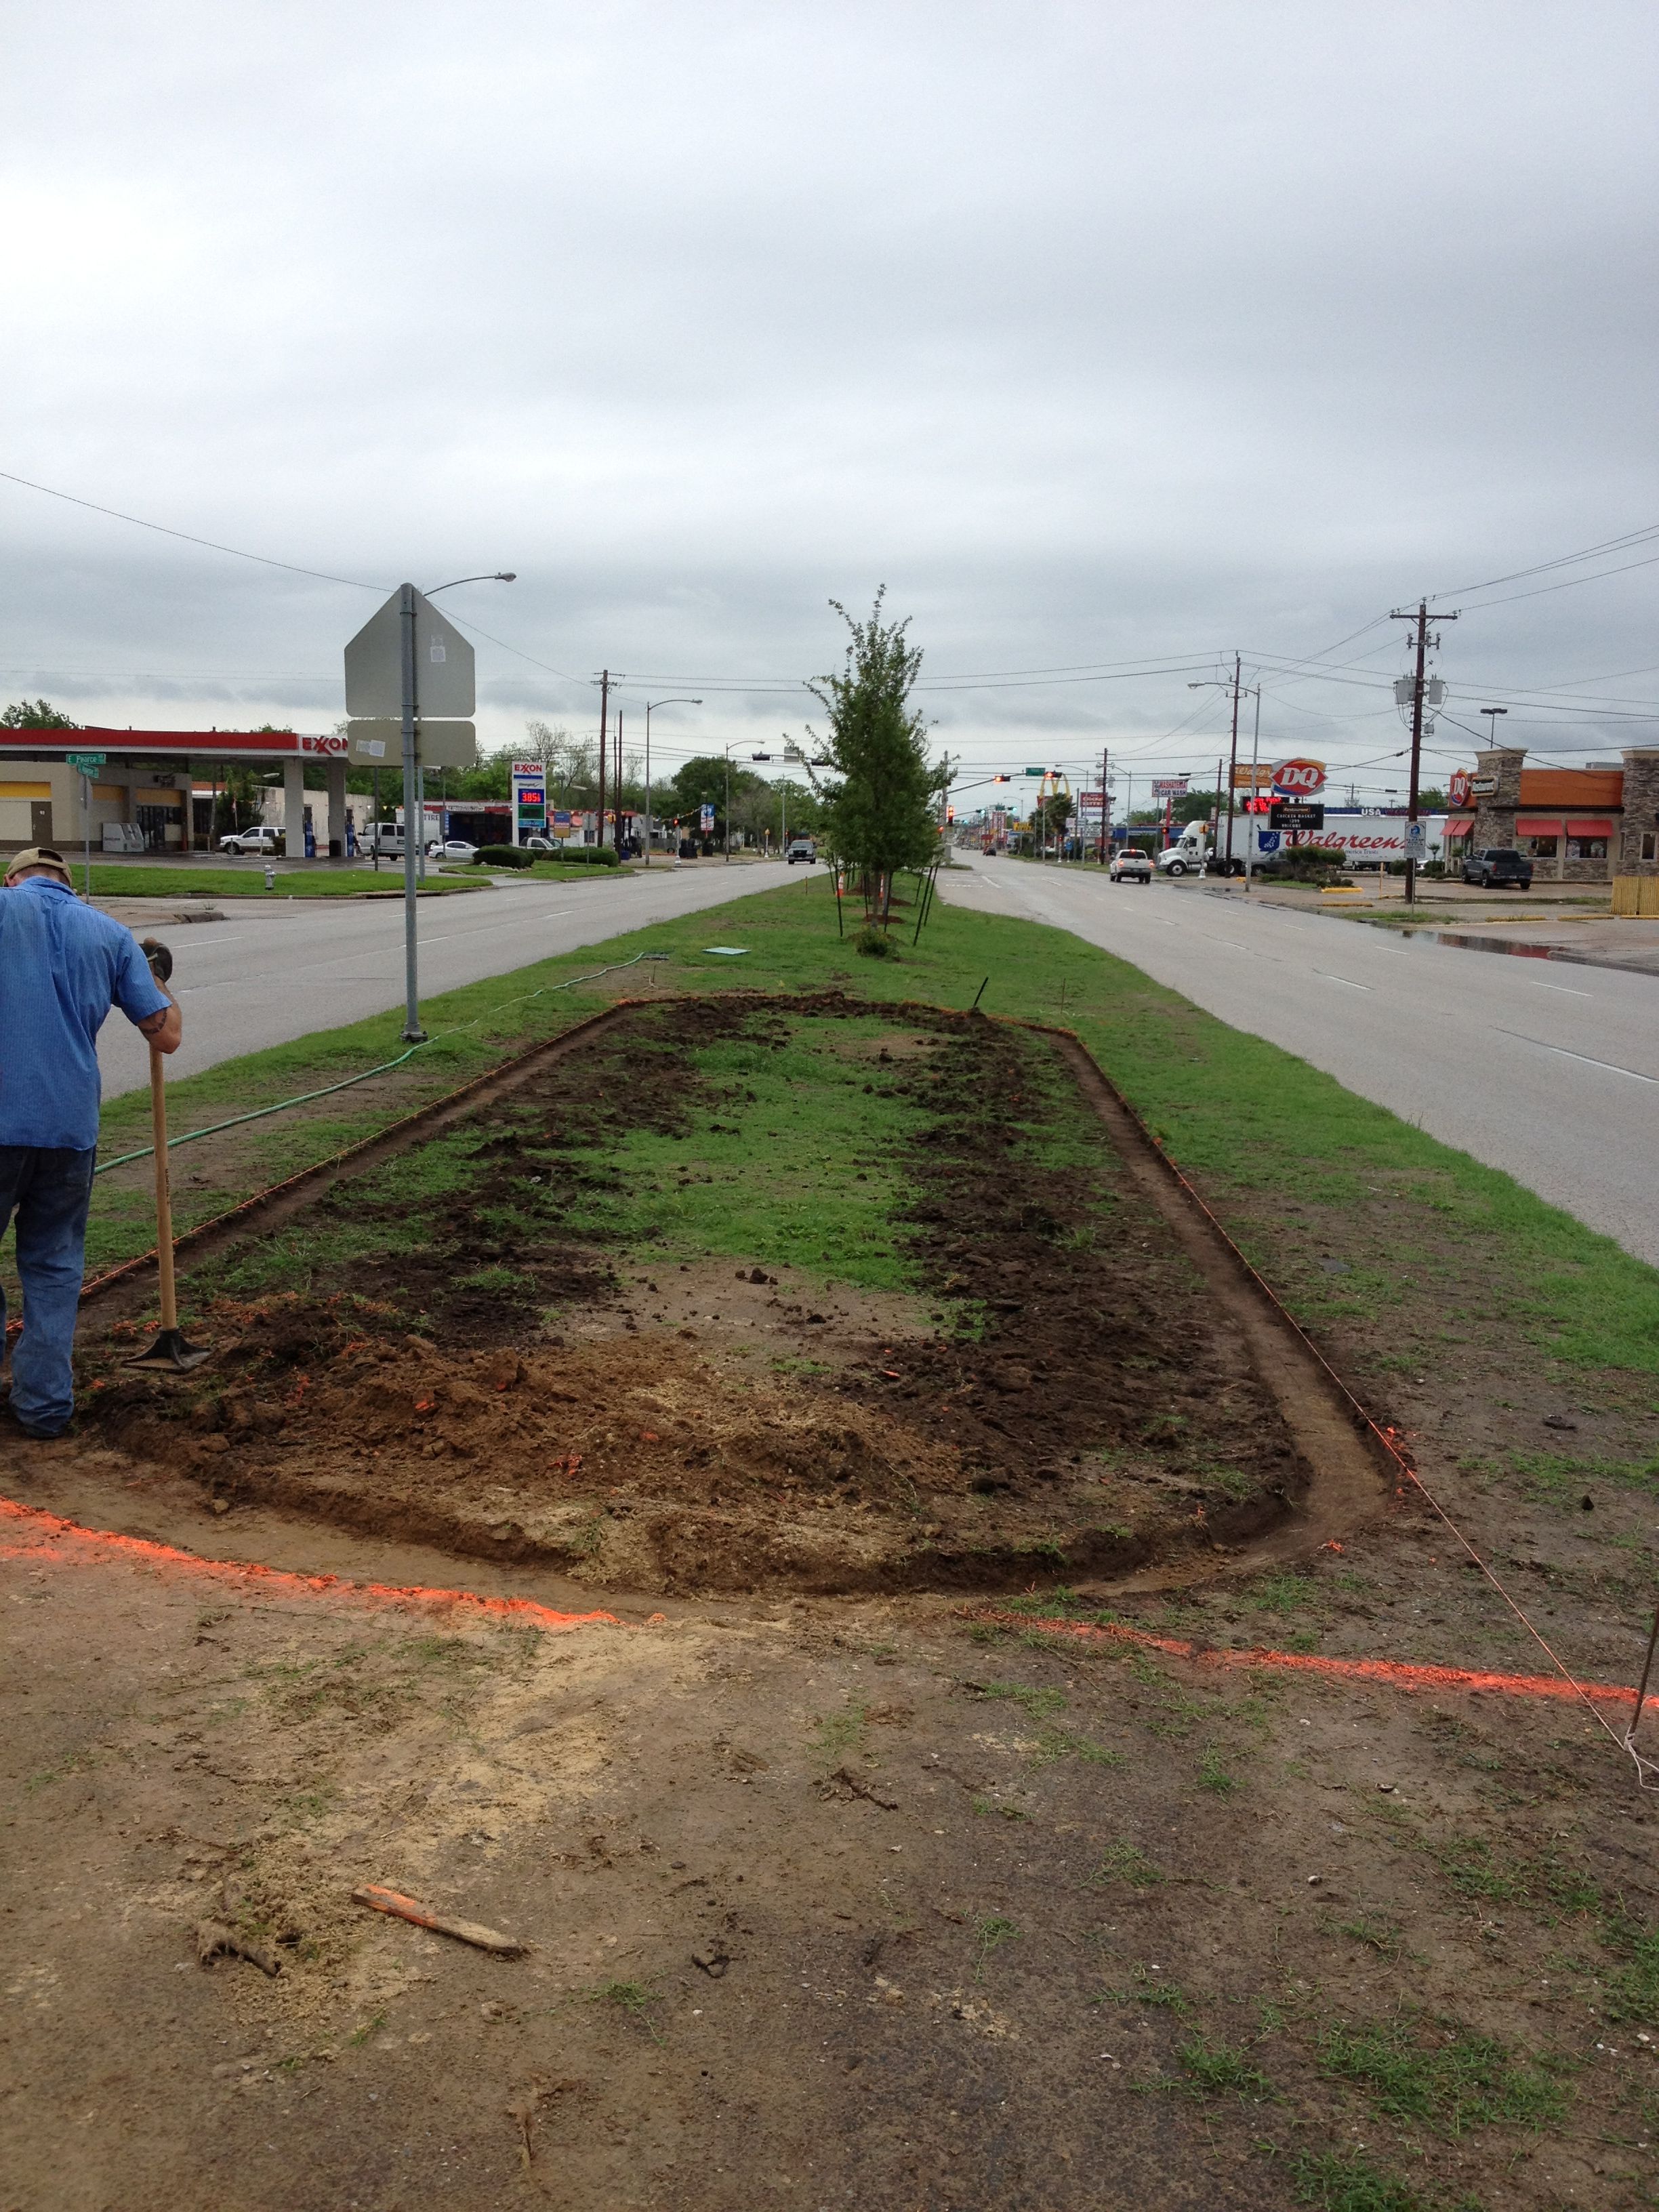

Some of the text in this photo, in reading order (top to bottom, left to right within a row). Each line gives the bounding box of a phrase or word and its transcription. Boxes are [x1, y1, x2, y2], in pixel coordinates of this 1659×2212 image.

[77, 755, 97, 763] Pearce
[514, 764, 543, 774] EXXON
[1280, 767, 1319, 788] DQ
[1361, 808, 1381, 816] USA
